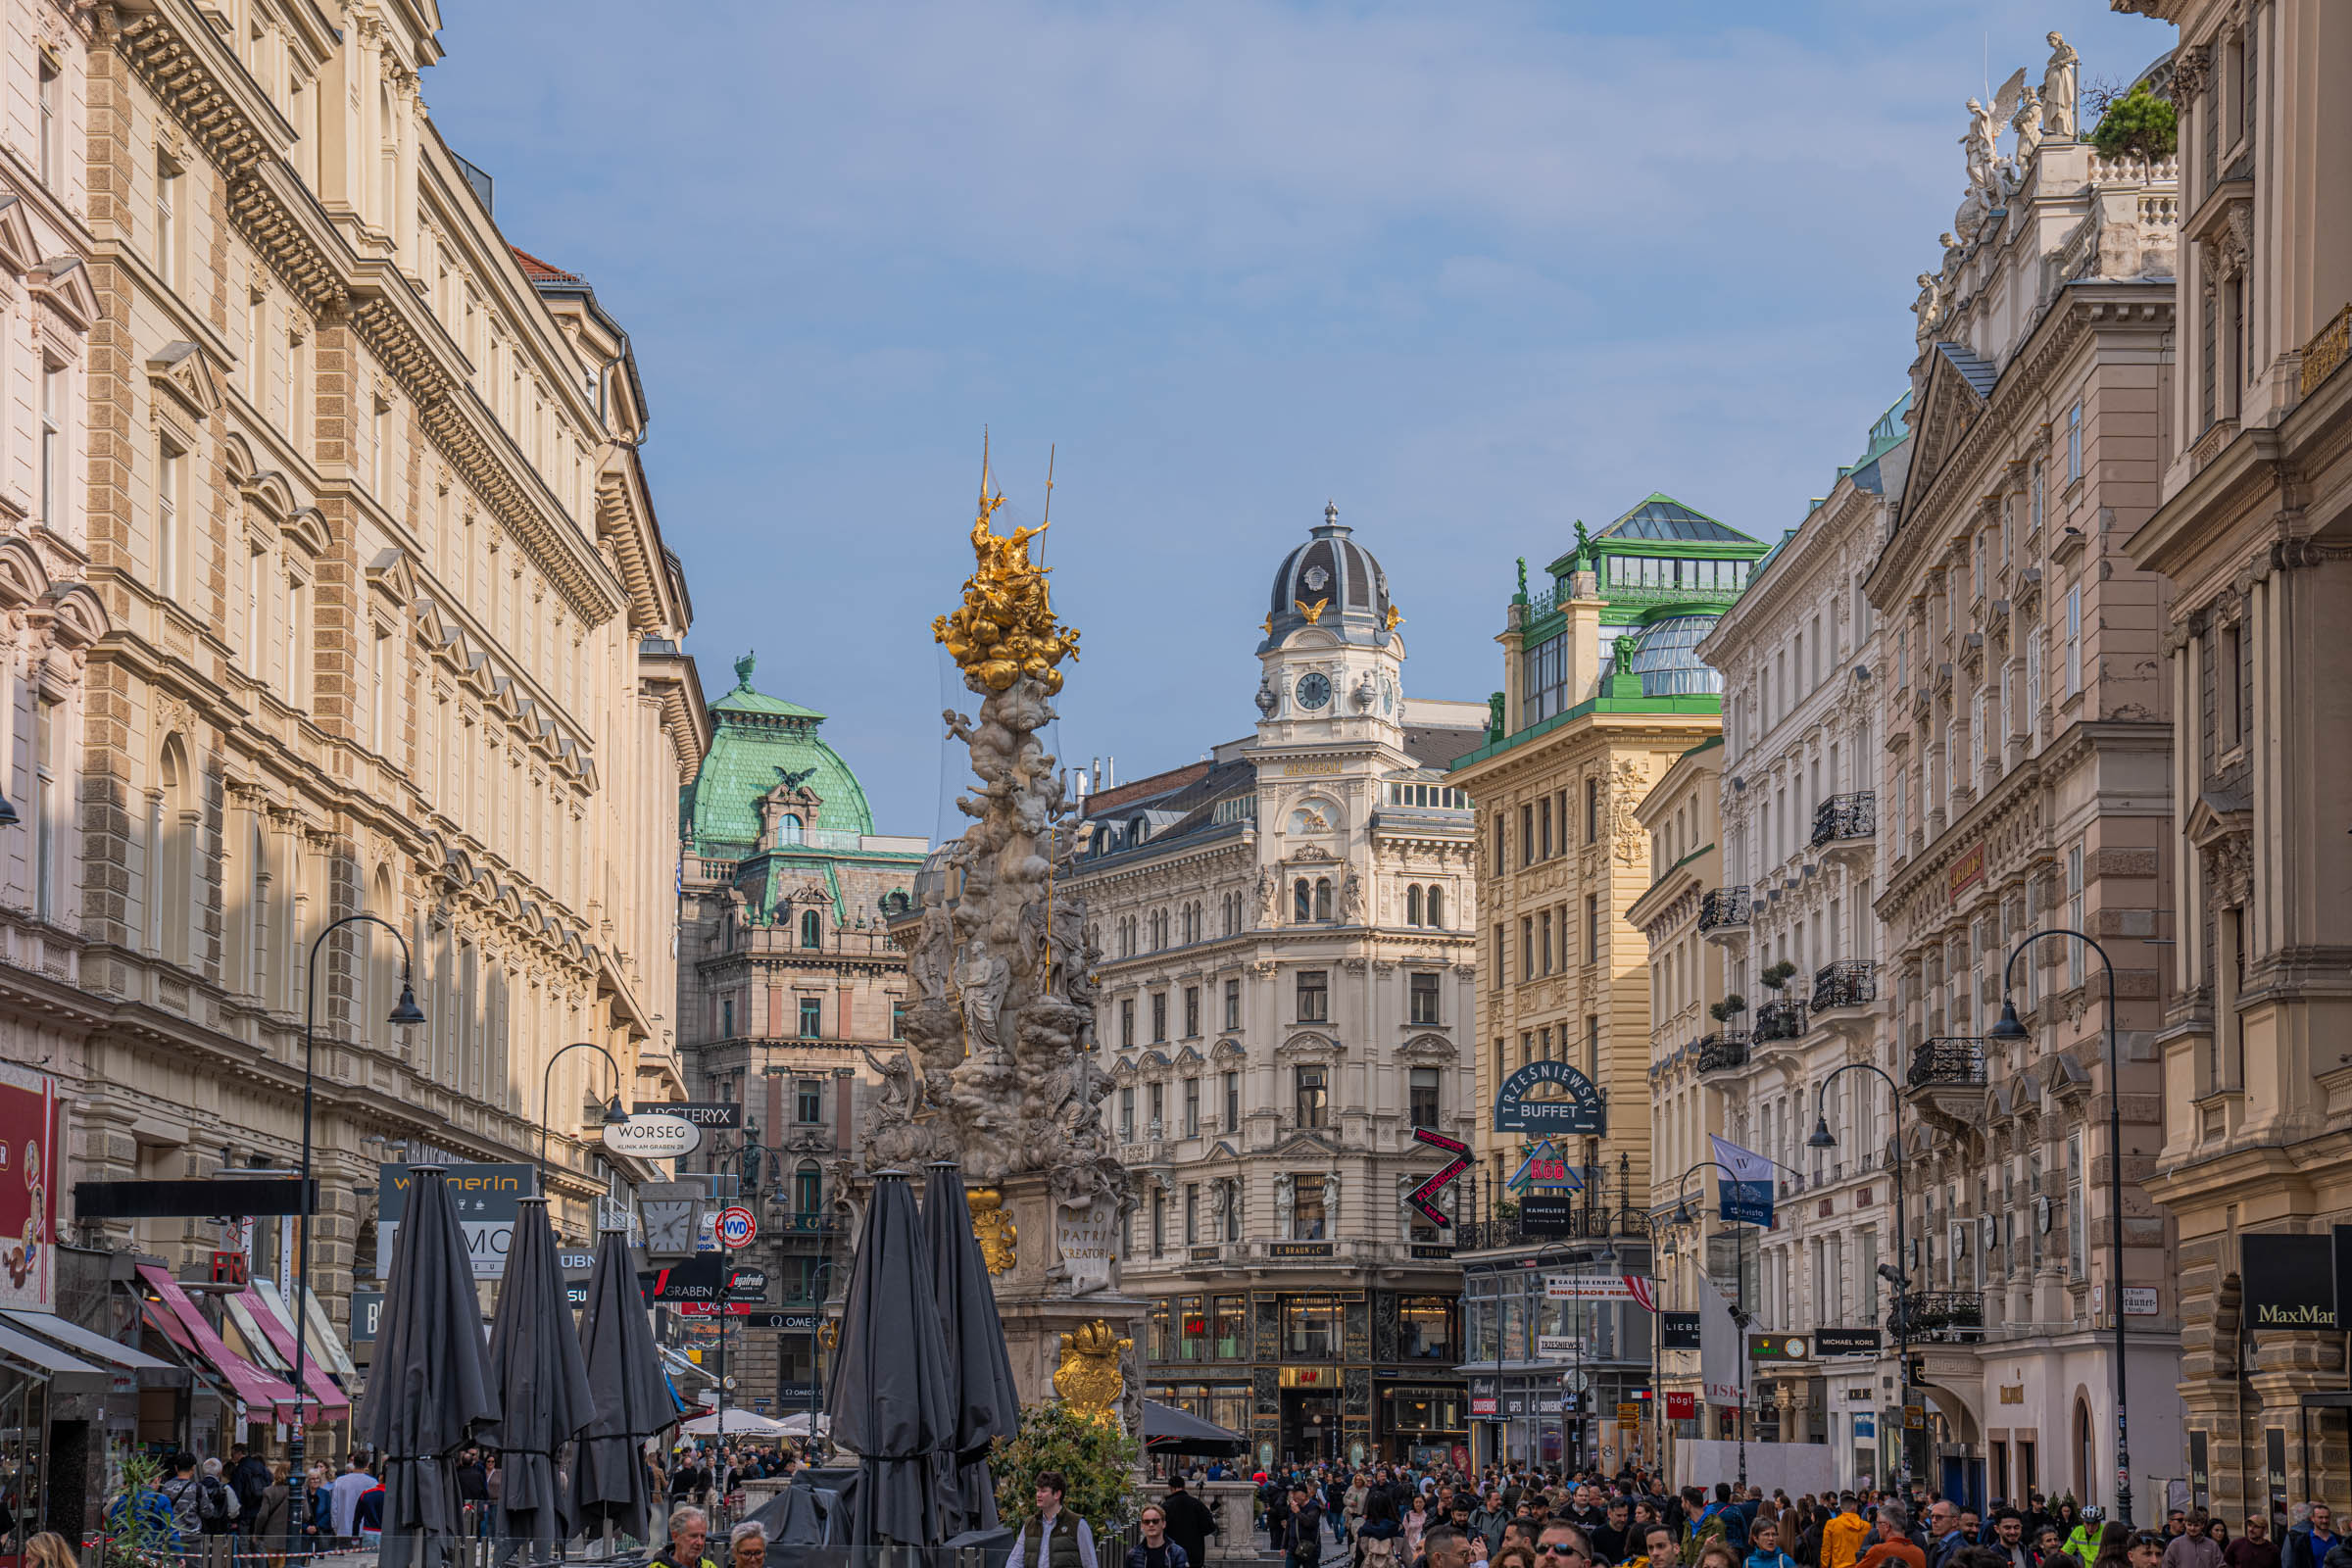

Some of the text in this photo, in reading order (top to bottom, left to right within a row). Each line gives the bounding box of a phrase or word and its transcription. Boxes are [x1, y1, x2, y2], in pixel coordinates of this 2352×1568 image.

[1521, 1104, 1578, 1118] BUFFET
[618, 1126, 685, 1138] WORSEG
[1531, 1159, 1564, 1180] Köö
[1416, 1160, 1467, 1201] FLEDERMAUS
[1063, 1229, 1106, 1242] PATRI
[1285, 1246, 1309, 1254] BRAUN
[561, 1254, 596, 1267] ÜBN
[666, 1286, 712, 1297] GRABEN
[2125, 1297, 2156, 1307] räuner-
[2257, 1303, 2335, 1324] MaxMar
[1473, 1400, 1496, 1412] SOUVENIRS
[1509, 1400, 1521, 1411] GIFTS
[1669, 1396, 1692, 1406] högl
